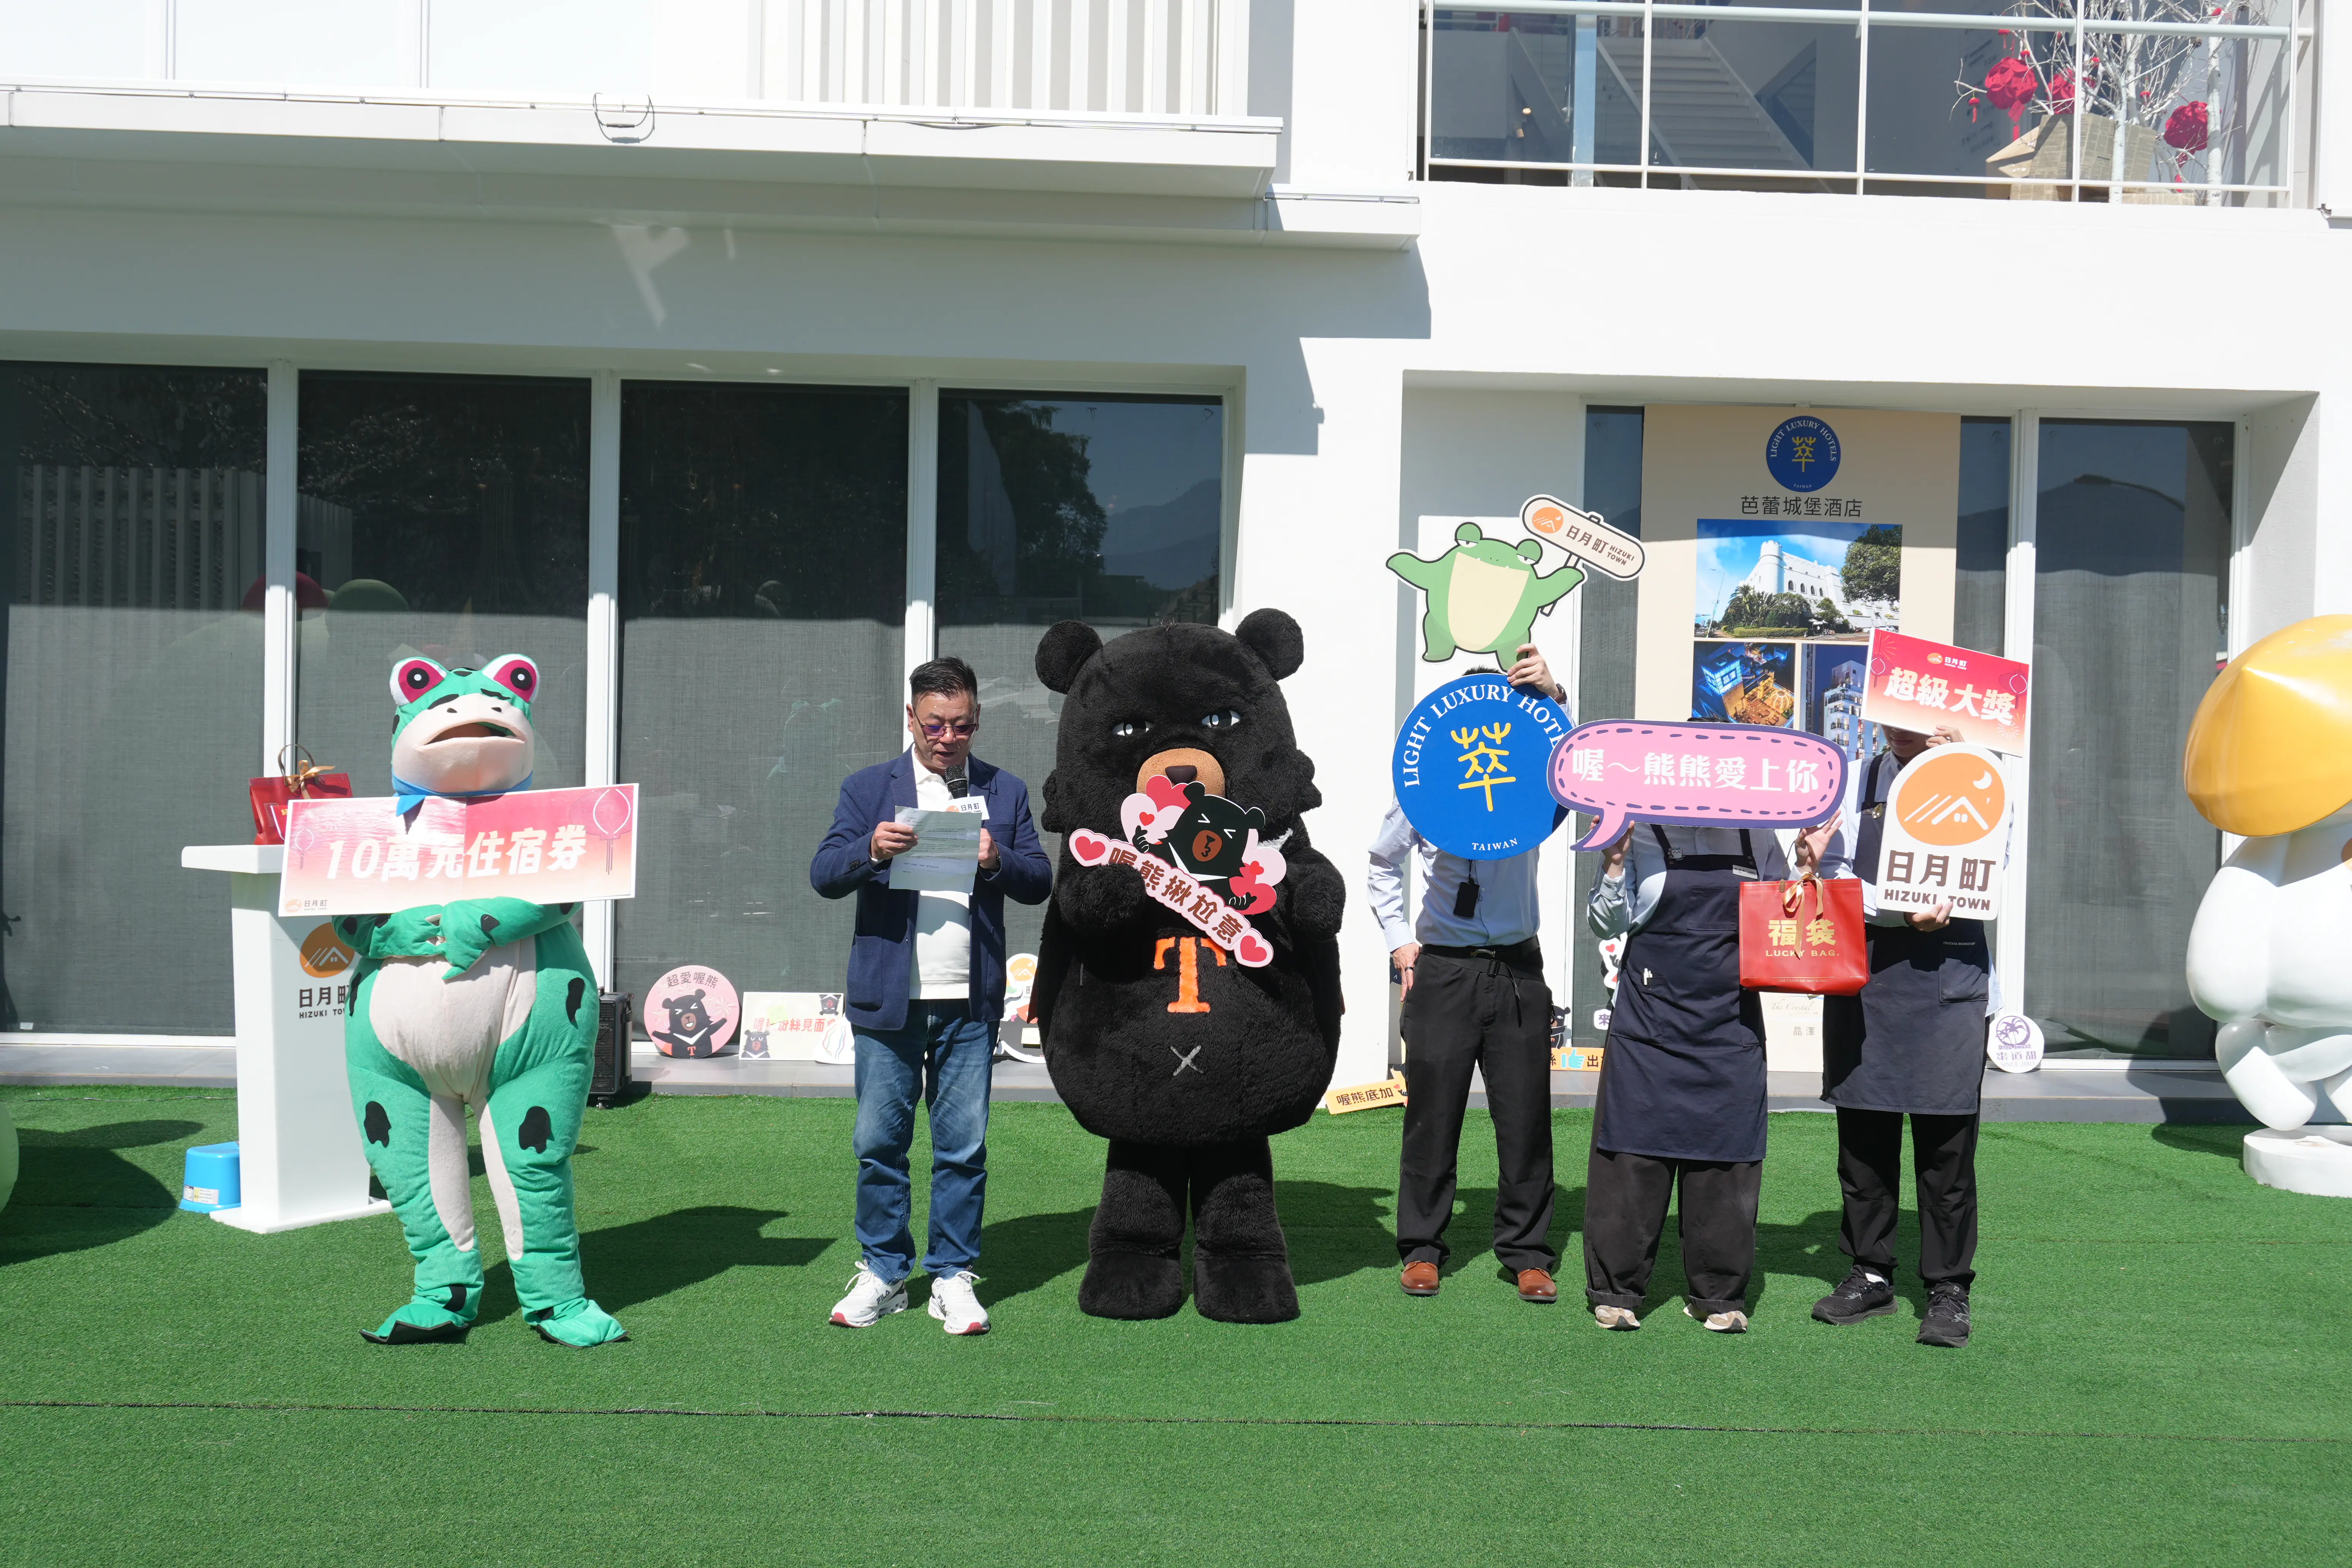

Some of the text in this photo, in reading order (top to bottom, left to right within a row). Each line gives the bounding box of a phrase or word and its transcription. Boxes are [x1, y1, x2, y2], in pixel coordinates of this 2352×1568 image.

[1770, 420, 1837, 462] LIGHT LUXURY HOTELS
[1740, 495, 1863, 517] 芭蕾城堡酒店
[1566, 525, 1609, 553] 日月町
[1607, 551, 1627, 566] TOWN
[1609, 545, 1635, 561] HIZUKI
[1944, 656, 1968, 667] 日月町
[1883, 665, 2018, 726] 超級大獎
[1403, 716, 1432, 788] LIGHT
[1429, 684, 1516, 719] LUXURY
[961, 802, 979, 811] 日月町
[327, 824, 587, 881] 10萬元住宿券
[1472, 837, 1518, 851] TAIWAN
[1886, 850, 1996, 892] 日月町
[1884, 889, 1991, 912] HIZUKI TOWN
[1768, 919, 1837, 947] 福袋
[666, 971, 719, 989] 超愛喔熊
[299, 1010, 327, 1019] HIZUKI
[1793, 1026, 1815, 1036] 晶澤
[1336, 1087, 1394, 1106] 喔熊底加
[876, 1290, 890, 1305] FILA
